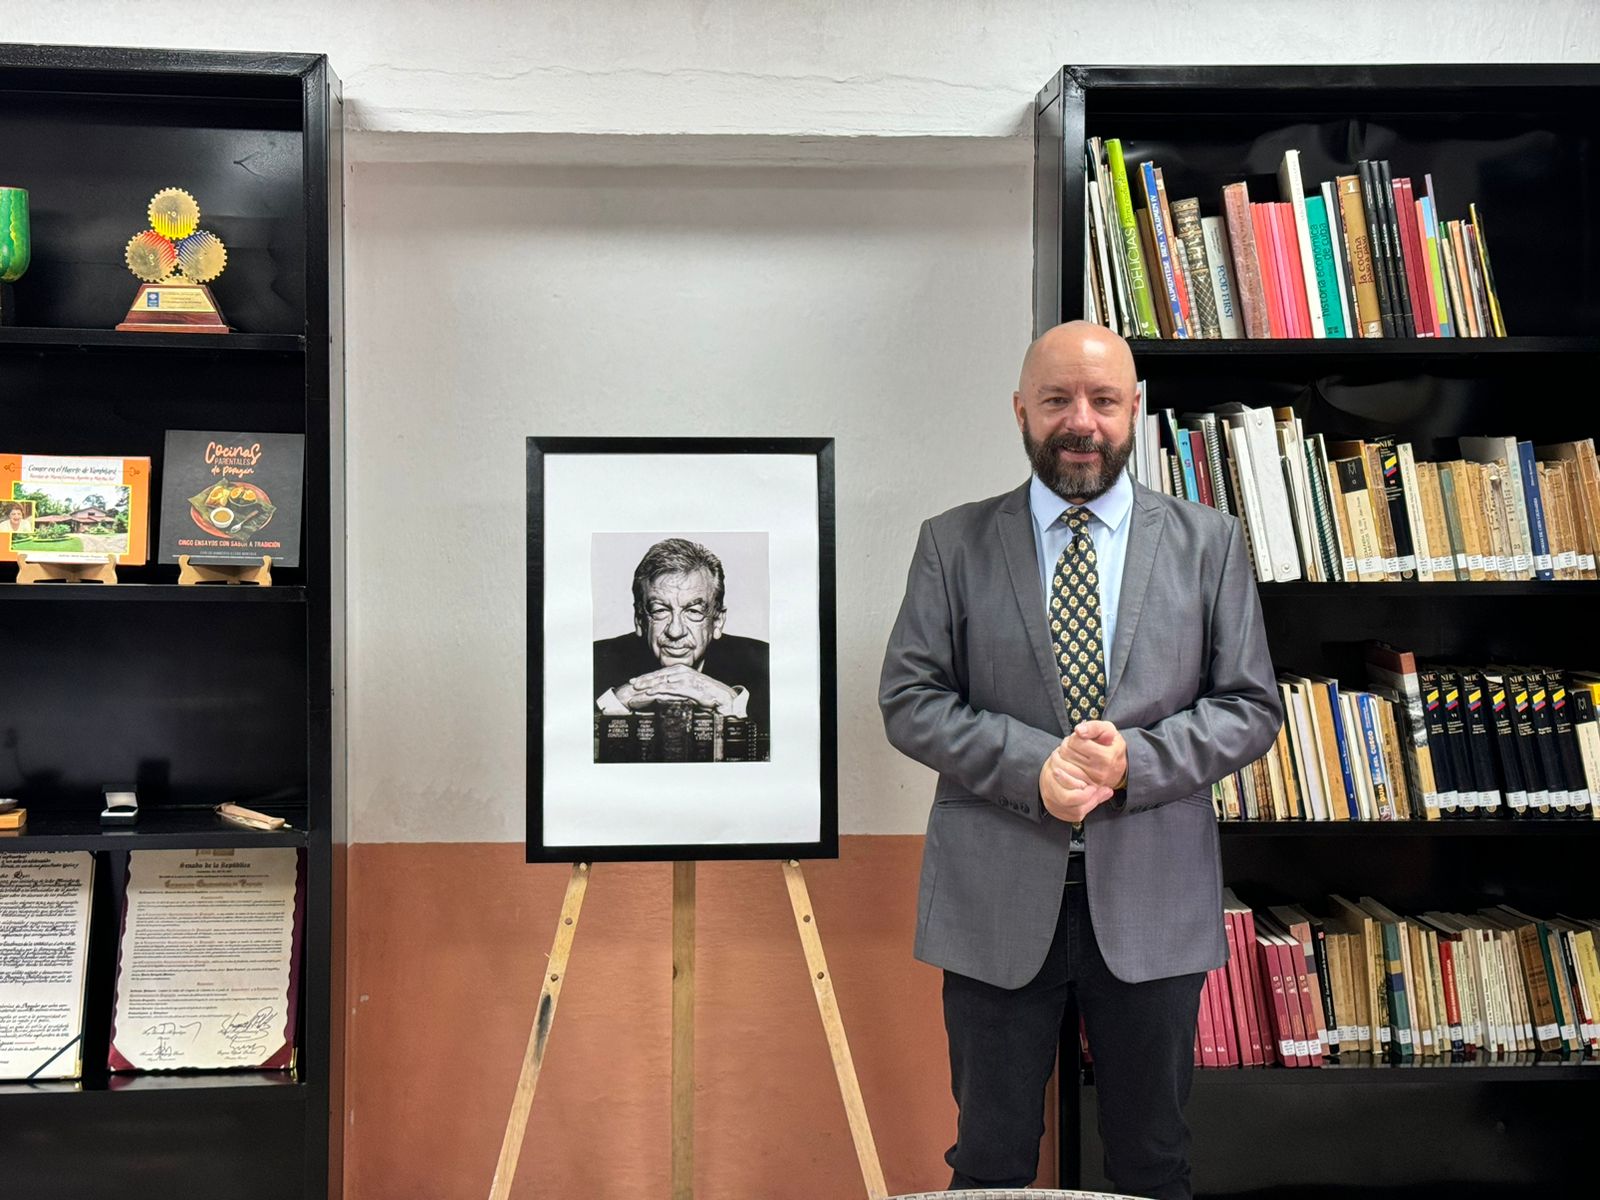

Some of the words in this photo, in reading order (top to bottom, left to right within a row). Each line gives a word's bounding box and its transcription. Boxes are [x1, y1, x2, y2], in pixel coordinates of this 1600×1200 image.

[1152, 202, 1163, 235] VOLUMEN
[1318, 222, 1329, 246] cuba
[1125, 227, 1143, 289] DELICIAS
[1158, 241, 1168, 257] BIEN
[1310, 224, 1324, 277] económica
[1324, 248, 1332, 260] de
[1354, 237, 1366, 272] cocina
[1163, 260, 1177, 302] ALIMENTESE
[1217, 264, 1229, 292] FOOD
[1358, 274, 1367, 284] la
[1222, 294, 1233, 319] FIRST
[1318, 280, 1328, 318] historia
[204, 441, 262, 466] Cocinas
[214, 458, 250, 466] PARENTALES
[1368, 730, 1377, 754] CUSCO
[1378, 784, 1386, 802] GUIA
